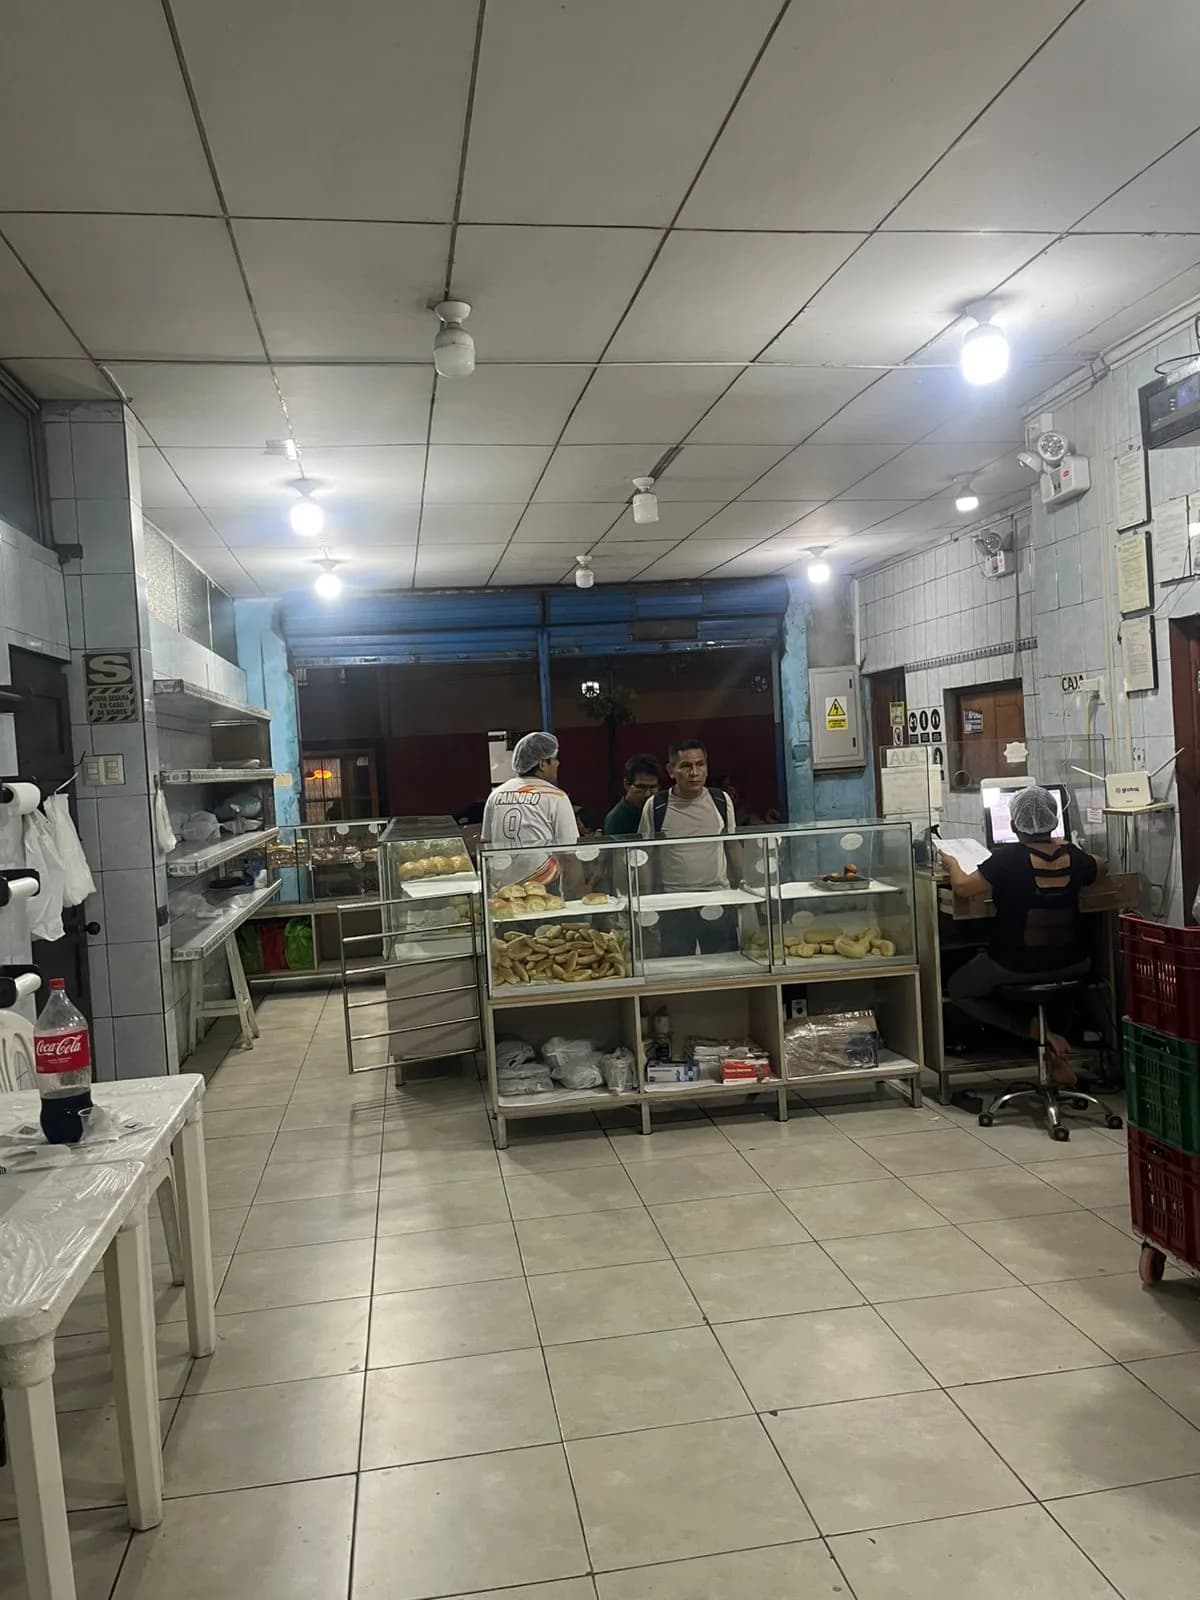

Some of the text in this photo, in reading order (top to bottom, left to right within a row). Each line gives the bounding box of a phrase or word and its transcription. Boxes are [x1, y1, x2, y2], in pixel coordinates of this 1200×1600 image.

[89, 655, 132, 684] S
[496, 791, 541, 805] PANDURO
[36, 1035, 82, 1056] Coca-Cola
